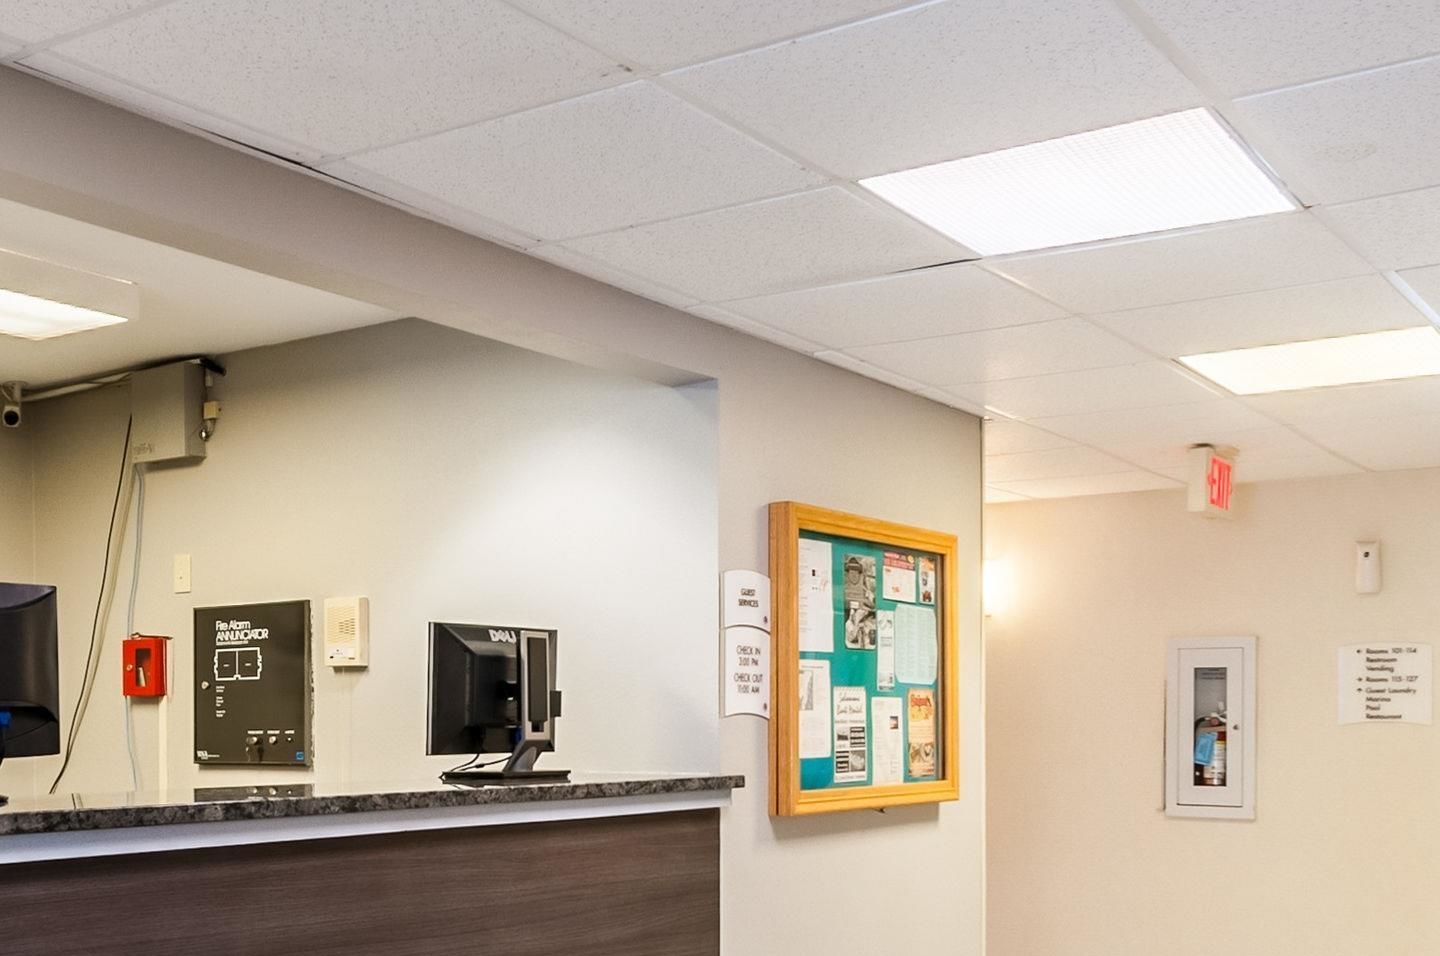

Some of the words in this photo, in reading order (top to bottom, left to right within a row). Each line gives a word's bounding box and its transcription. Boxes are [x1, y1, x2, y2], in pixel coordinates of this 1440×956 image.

[1211, 457, 1231, 511] EXIT
[740, 588, 755, 596] GUEST
[738, 599, 759, 608] SERVICES
[216, 620, 228, 631] Fire
[228, 620, 251, 630] Alarm
[216, 628, 269, 642] ANNUNCIATOR
[488, 629, 517, 643] DELL
[736, 645, 752, 655] CHECK
[754, 647, 761, 655] IN
[751, 658, 759, 666] PM
[734, 673, 750, 682] CHECK
[752, 674, 763, 683] OUT
[751, 685, 760, 694] AM
